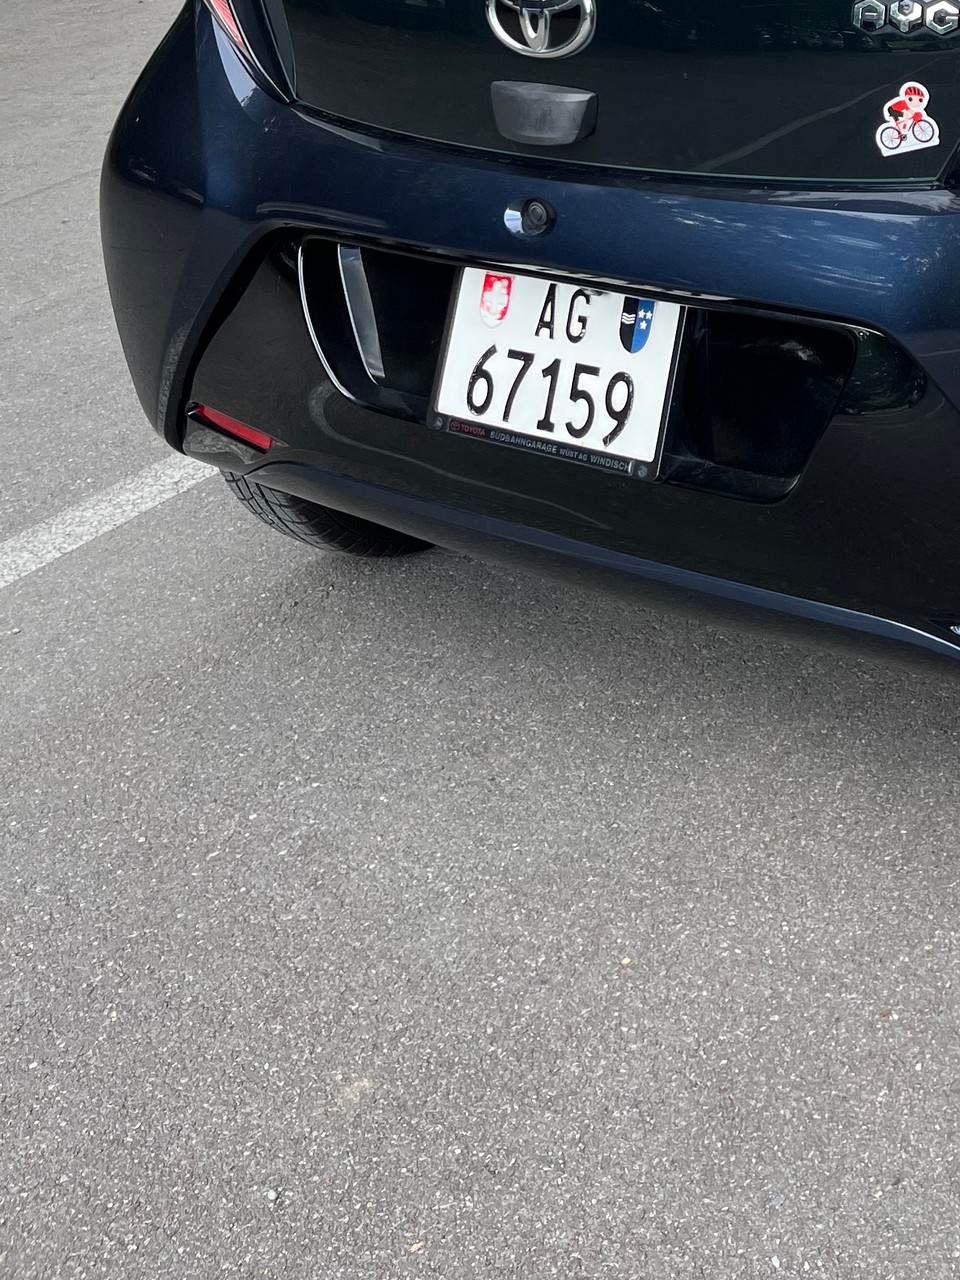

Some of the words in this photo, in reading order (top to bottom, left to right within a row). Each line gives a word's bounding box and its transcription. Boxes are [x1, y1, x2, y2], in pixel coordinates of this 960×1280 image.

[534, 283, 591, 343] AG
[466, 344, 635, 448] 67159
[460, 423, 486, 436] TOYOTA
[590, 455, 630, 471] WINDISCH
